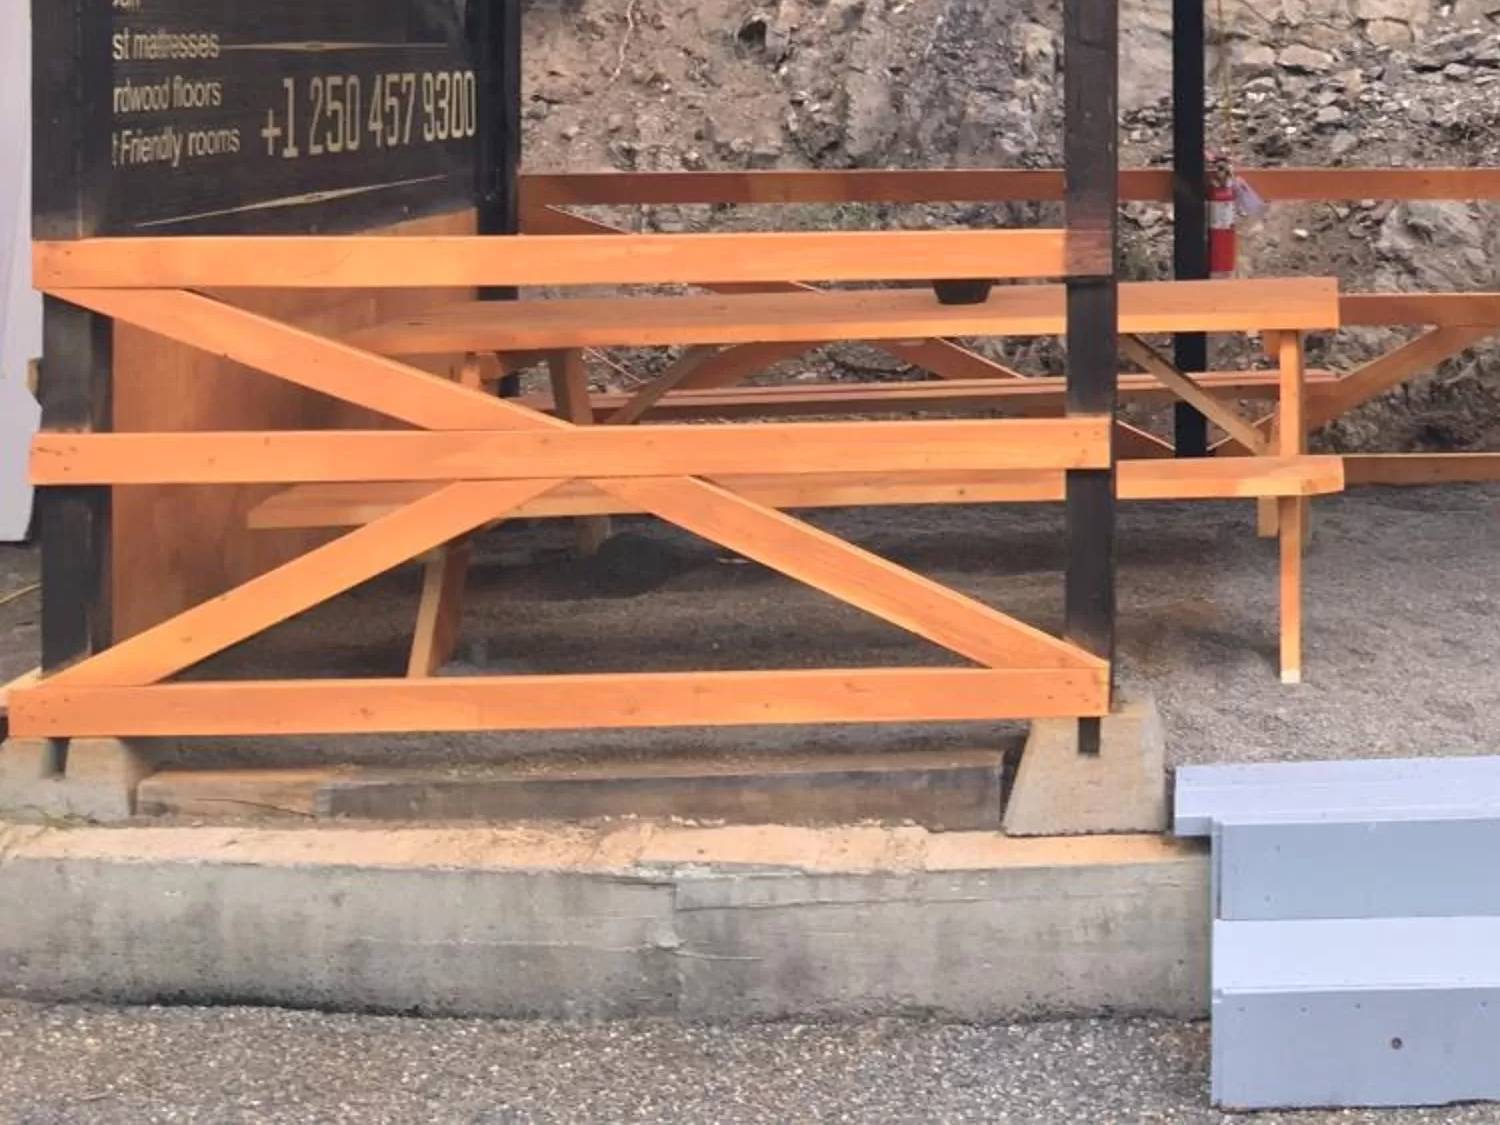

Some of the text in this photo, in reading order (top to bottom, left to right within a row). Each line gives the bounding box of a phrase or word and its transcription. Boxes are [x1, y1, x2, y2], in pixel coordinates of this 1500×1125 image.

[112, 27, 220, 60] st mattresses
[112, 74, 222, 114] rdwood floors
[261, 70, 477, 159] +1 250 457 9300
[120, 127, 183, 167] Friendly
[187, 128, 241, 156] rooms
